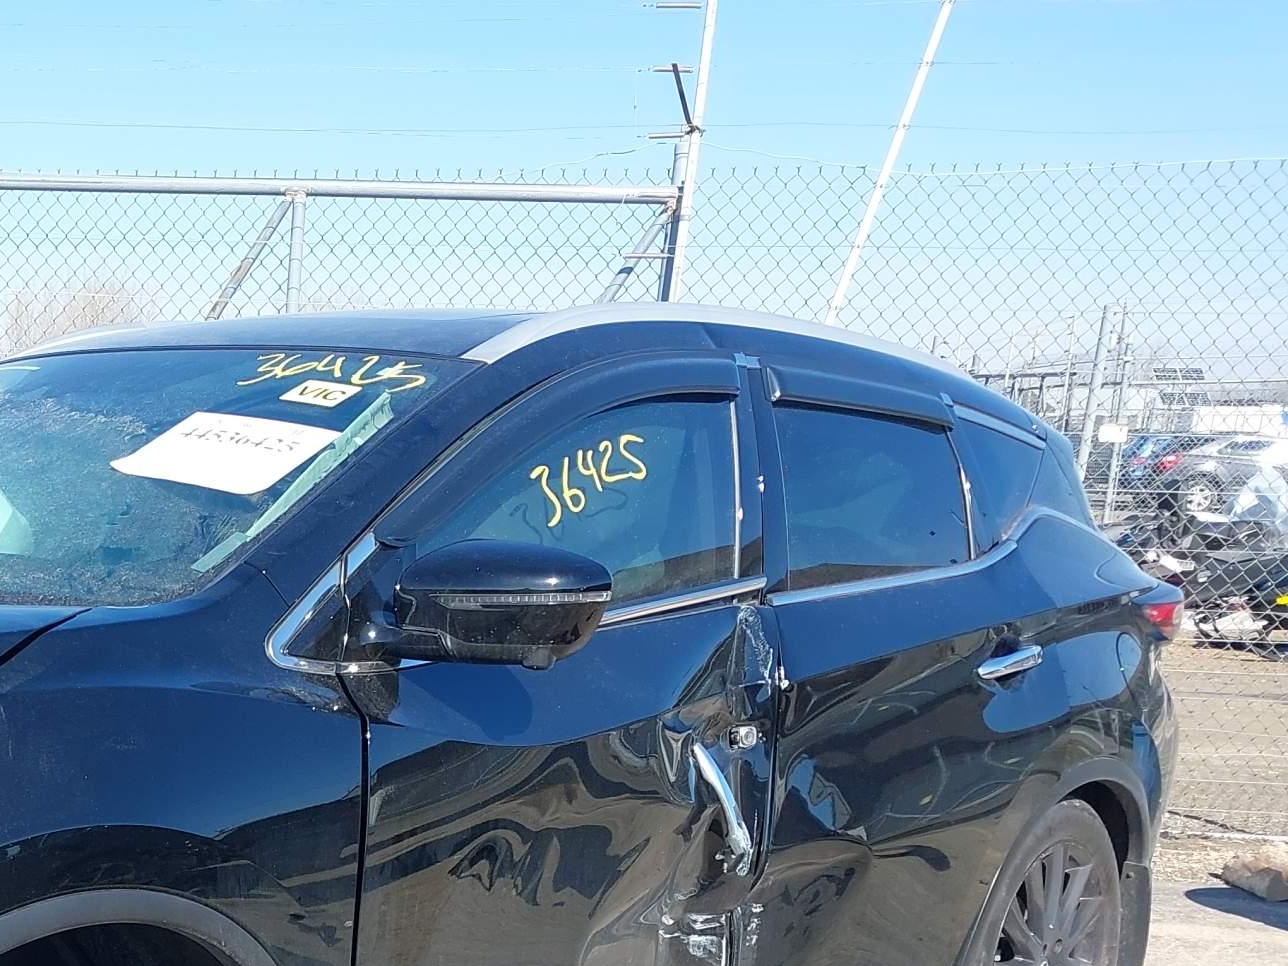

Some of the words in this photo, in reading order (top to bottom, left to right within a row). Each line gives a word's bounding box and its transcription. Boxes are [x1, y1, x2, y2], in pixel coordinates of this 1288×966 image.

[235, 352, 427, 394] 36425
[298, 385, 347, 401] VIC
[529, 433, 648, 528] 36425
